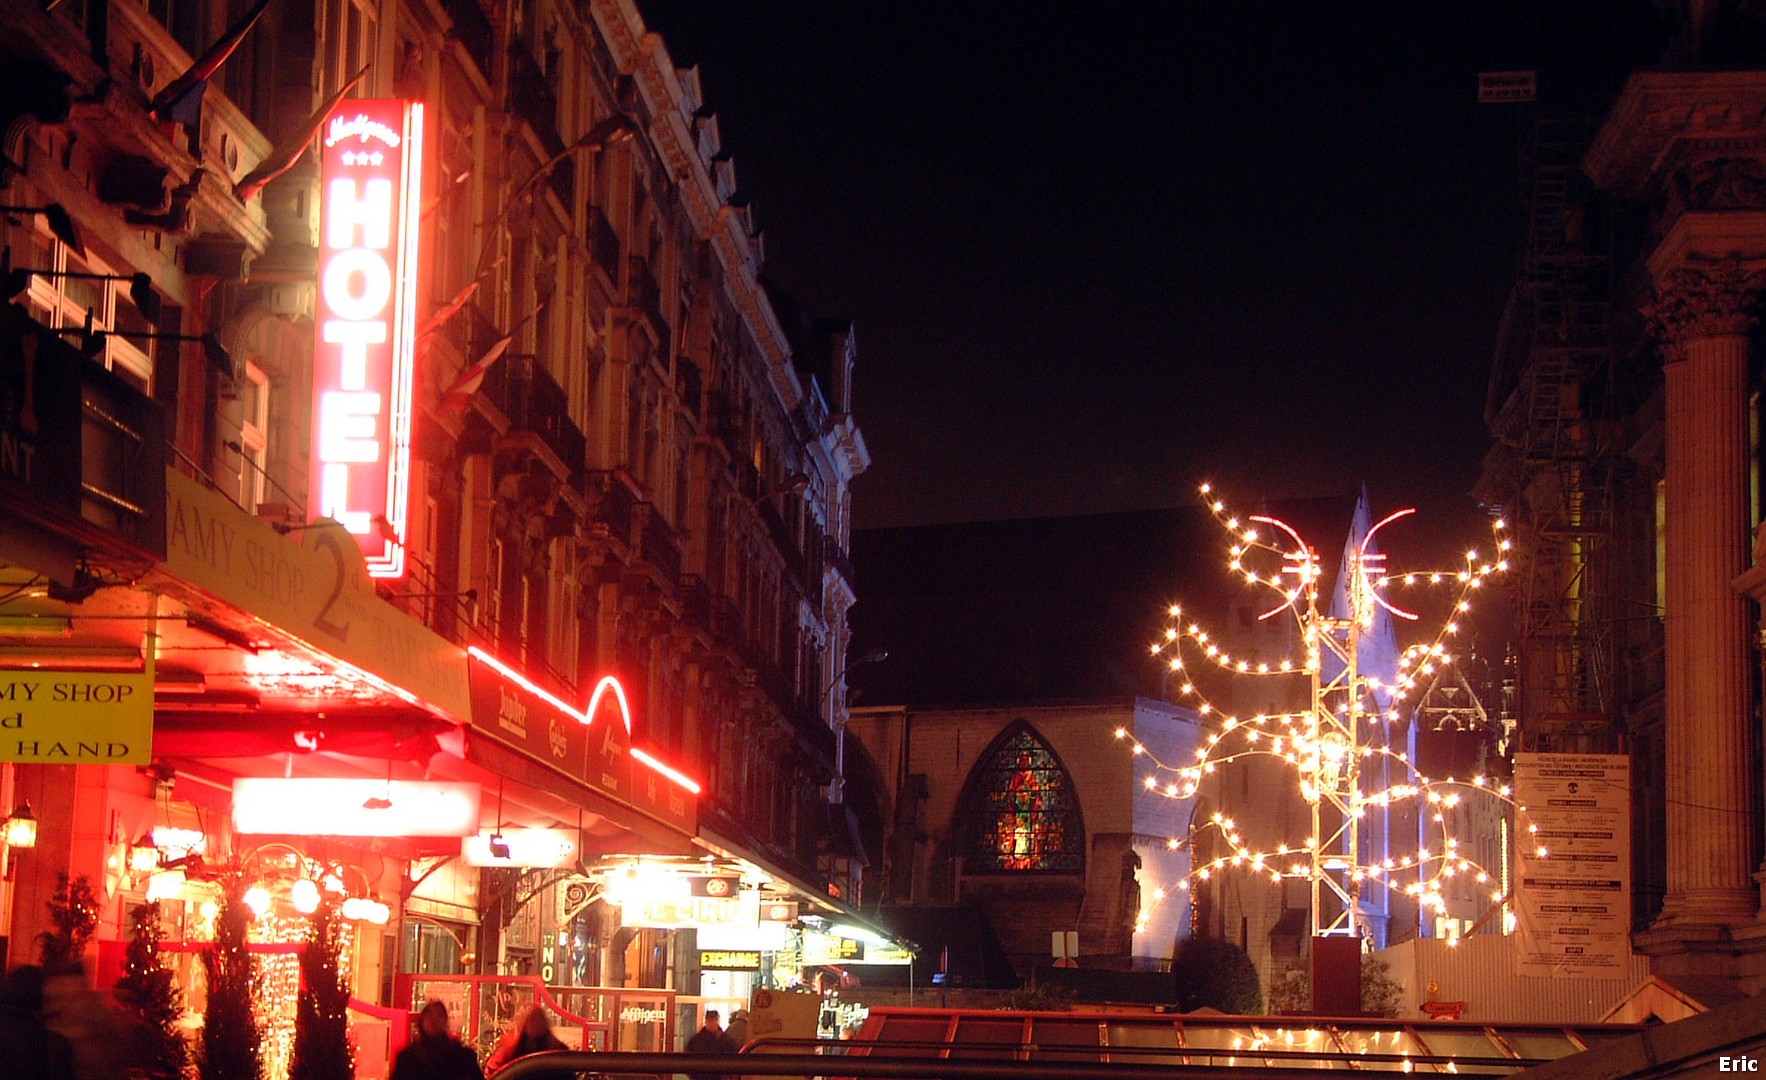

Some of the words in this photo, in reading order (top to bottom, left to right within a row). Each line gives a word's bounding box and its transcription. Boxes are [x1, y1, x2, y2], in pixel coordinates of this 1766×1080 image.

[319, 178, 392, 535] HOTEL
[53, 682, 133, 703] SHOP
[17, 741, 129, 758] HAND
